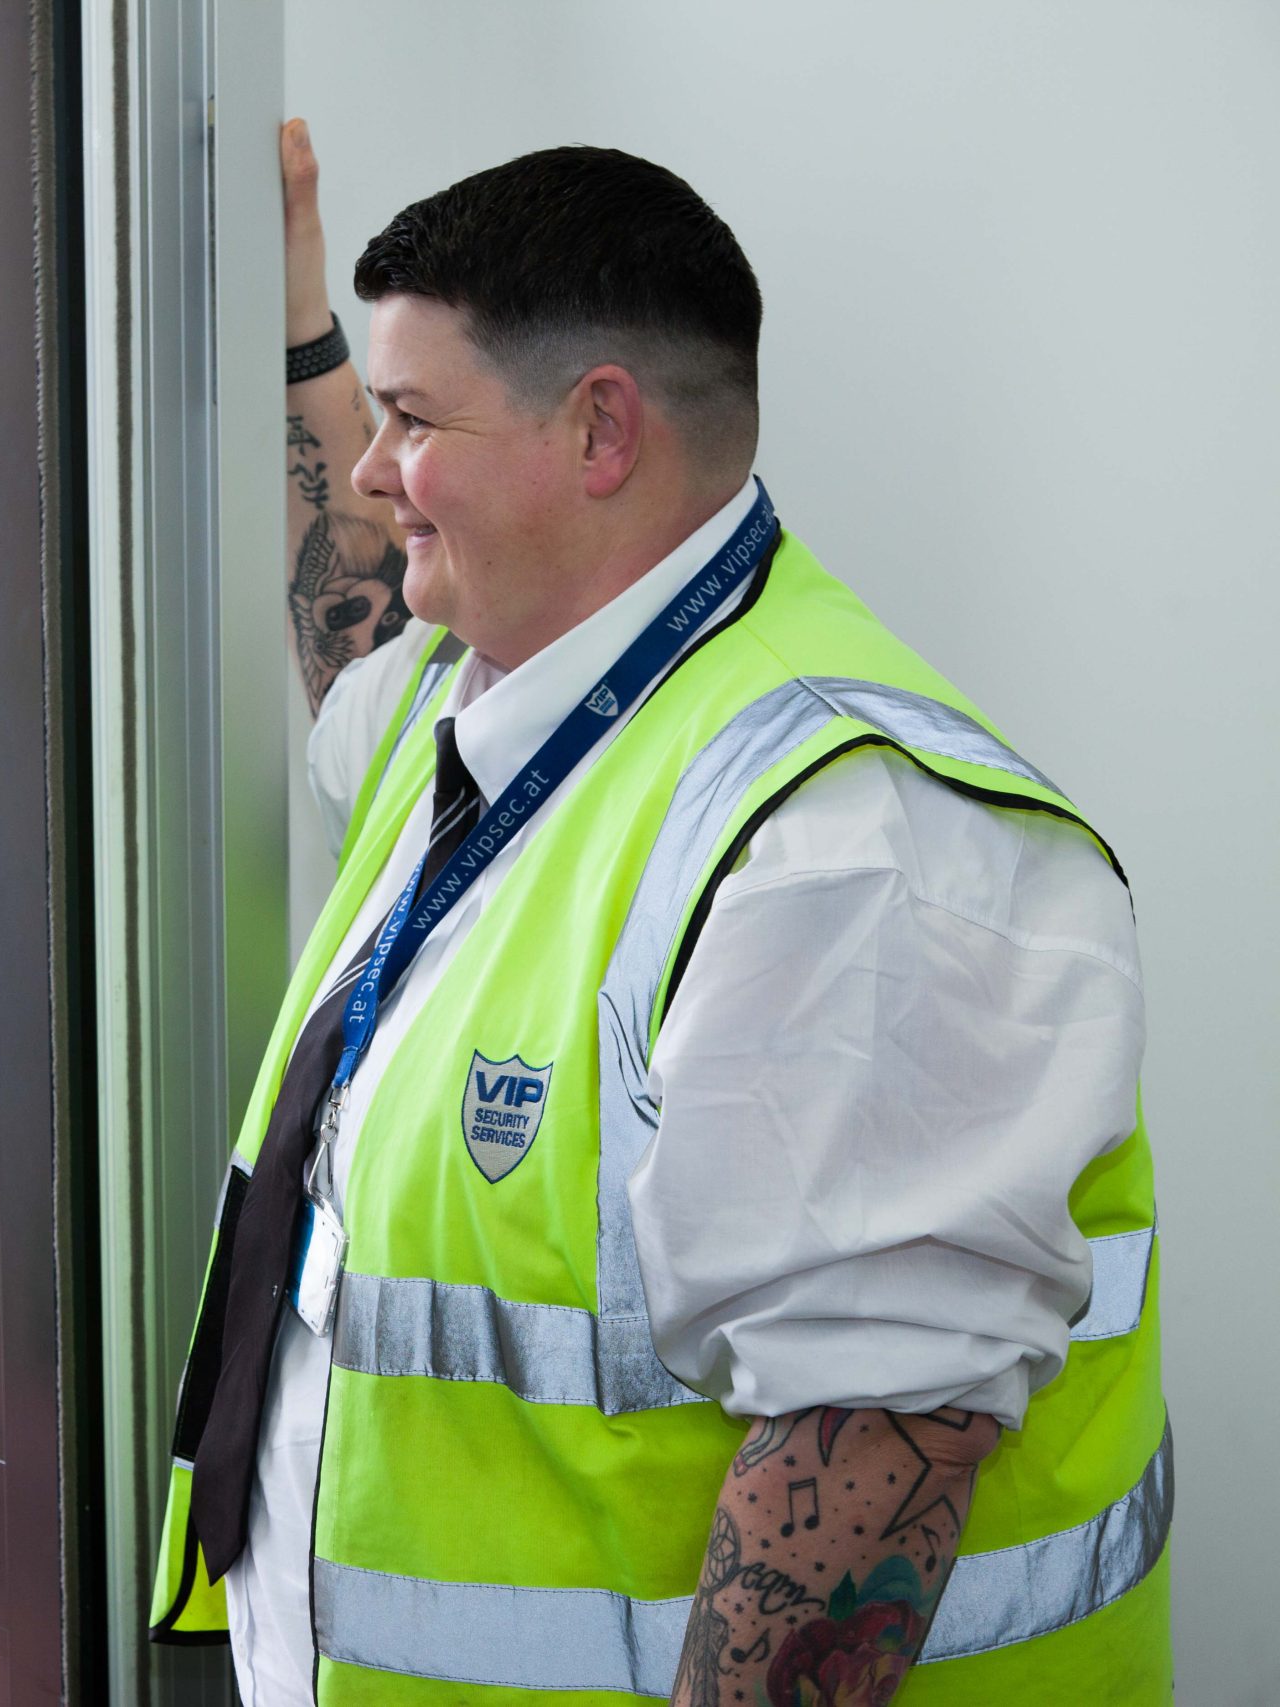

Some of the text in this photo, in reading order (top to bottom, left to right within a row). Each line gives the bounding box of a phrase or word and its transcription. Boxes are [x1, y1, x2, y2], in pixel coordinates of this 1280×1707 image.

[588, 687, 609, 708] VIP
[412, 768, 550, 931] www.vipsec.at
[476, 1071, 544, 1107] VIP
[475, 1107, 530, 1129] SECURITY
[471, 1125, 526, 1148] SERVICES
